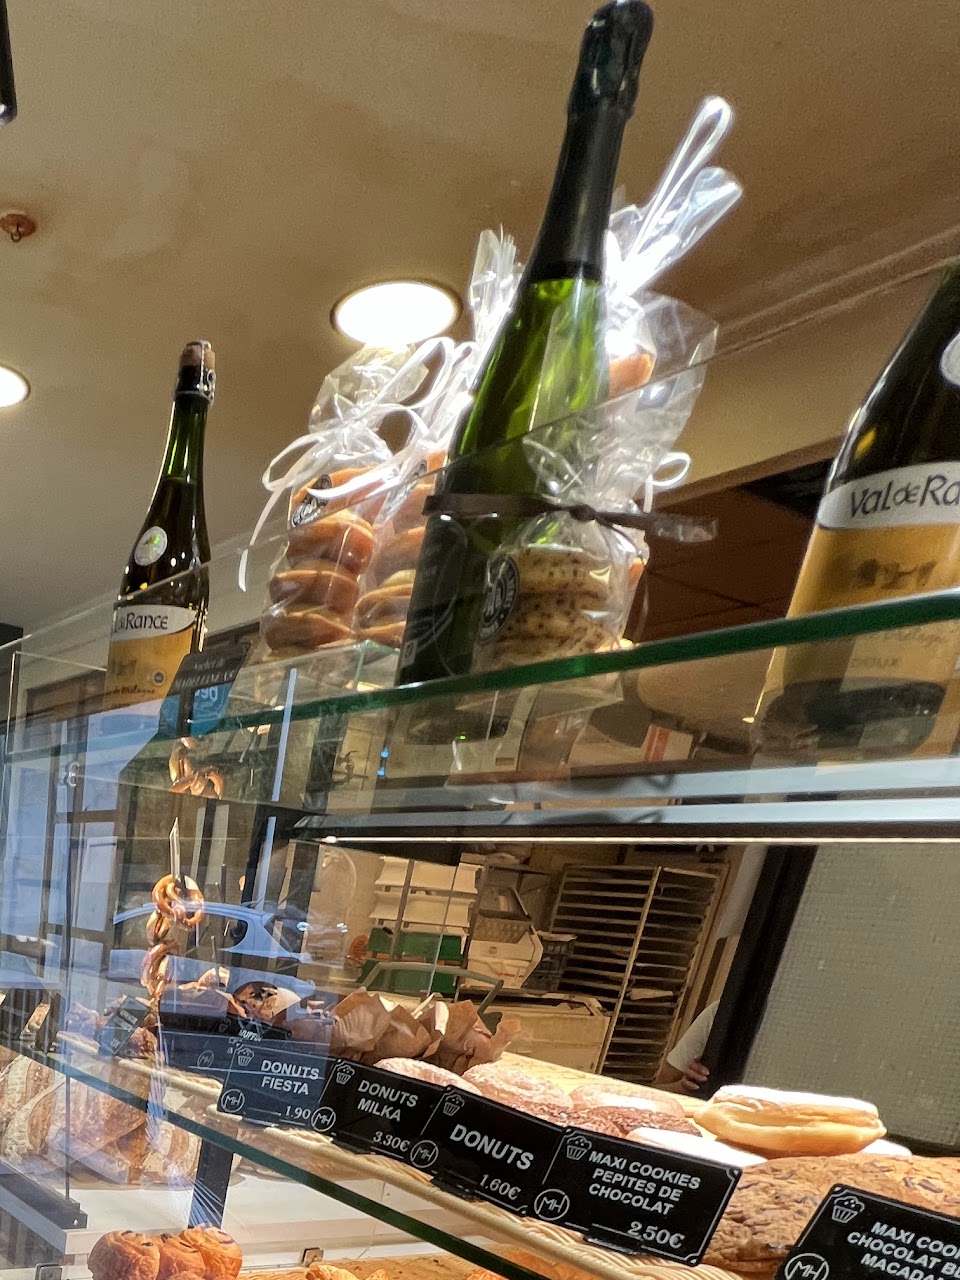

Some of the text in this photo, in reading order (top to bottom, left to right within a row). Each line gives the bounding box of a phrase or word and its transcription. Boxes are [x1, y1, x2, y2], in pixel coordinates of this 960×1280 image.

[851, 480, 894, 518] Val
[125, 612, 168, 630] Rance
[261, 1059, 320, 1081] DONUTS
[261, 1076, 309, 1095] FIESTA
[358, 1079, 419, 1107] DONUTS
[357, 1098, 401, 1122] MILKA
[372, 1130, 410, 1152] 3.30€
[449, 1123, 534, 1170] DONUTS
[588, 1150, 701, 1190] MAXI COOKIES
[592, 1168, 683, 1202] PEPITES DE
[479, 1174, 521, 1200] 1.60€
[588, 1183, 674, 1216] CHOCOLAT
[846, 1231, 941, 1270] CHOCOLAT
[870, 1221, 960, 1260] MAXI COO
